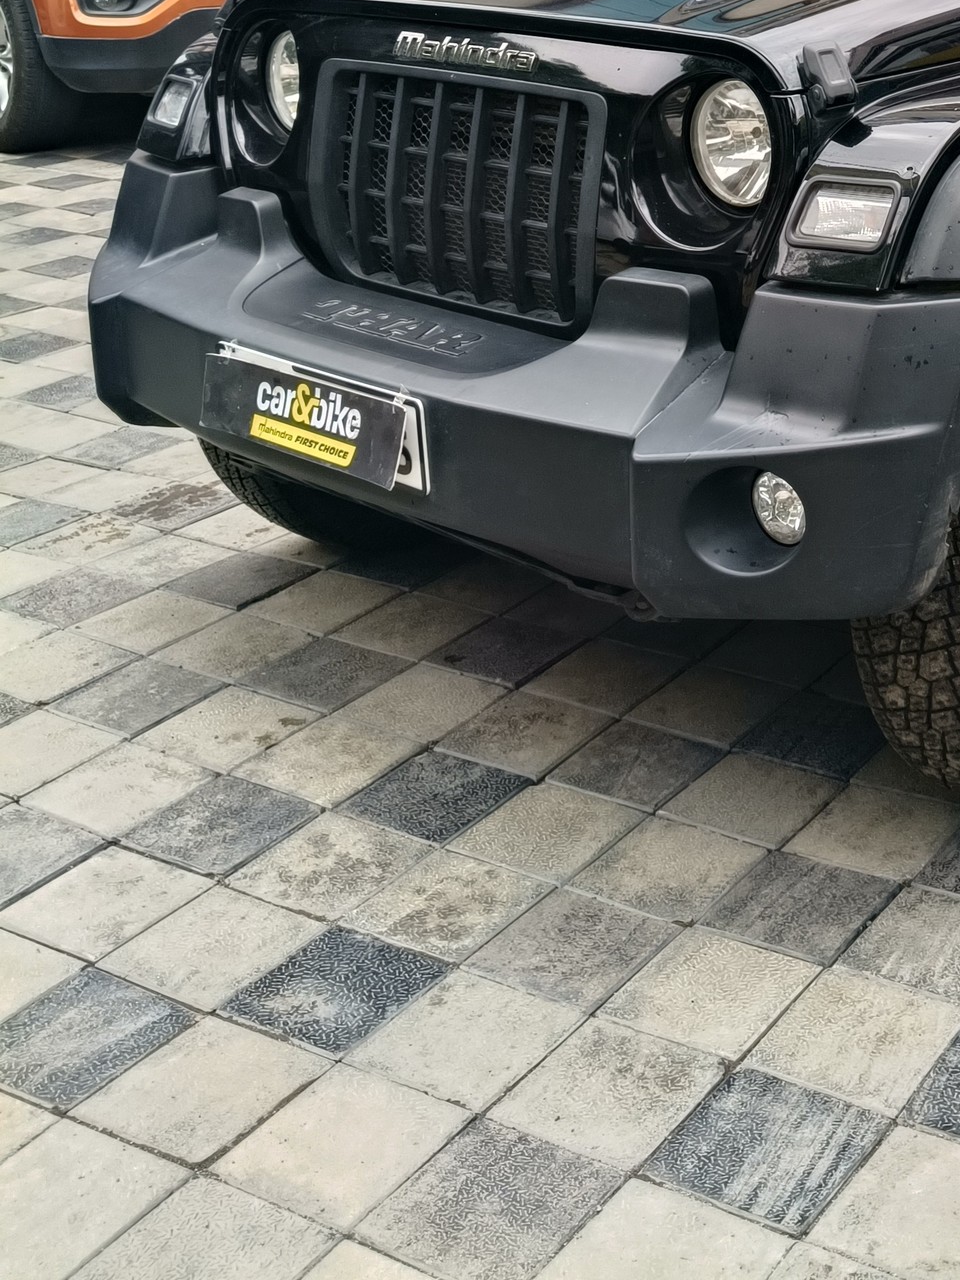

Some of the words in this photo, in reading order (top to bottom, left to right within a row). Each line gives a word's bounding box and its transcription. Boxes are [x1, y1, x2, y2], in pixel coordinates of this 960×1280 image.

[393, 30, 538, 73] Mahindra
[302, 298, 485, 357] THAR
[256, 381, 362, 440] car&bike
[257, 418, 293, 442] Mahindra
[294, 434, 319, 450] FIRST
[318, 439, 350, 460] CHOICE
